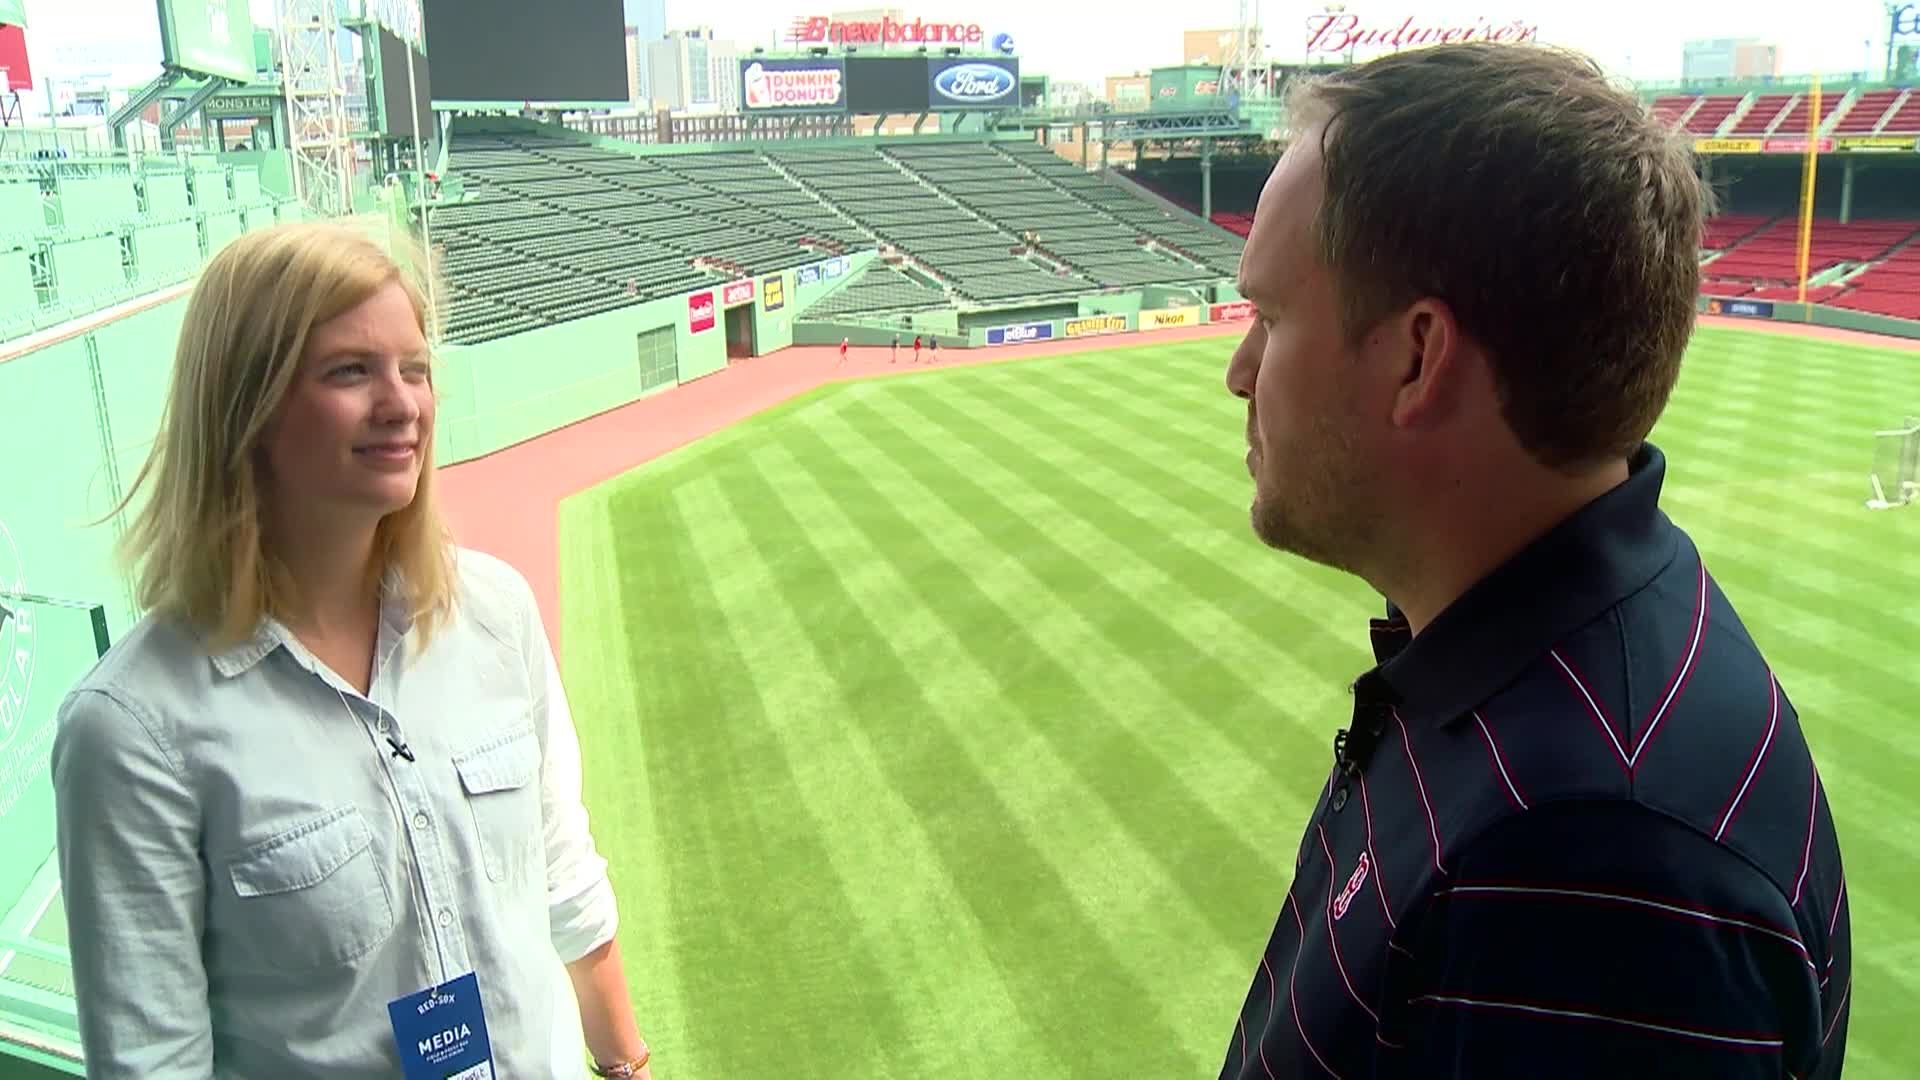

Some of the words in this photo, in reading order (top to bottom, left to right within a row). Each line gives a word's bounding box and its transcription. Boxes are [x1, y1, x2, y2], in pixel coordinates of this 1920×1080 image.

[1307, 14, 1538, 53] Budweiser
[773, 75, 839, 88] DUNKIN'
[951, 71, 999, 96] Ford
[773, 88, 836, 102] DONUTS
[206, 96, 271, 109] MONSTER
[1154, 313, 1185, 326] Nikon
[418, 1023, 472, 1056] MEDIA
